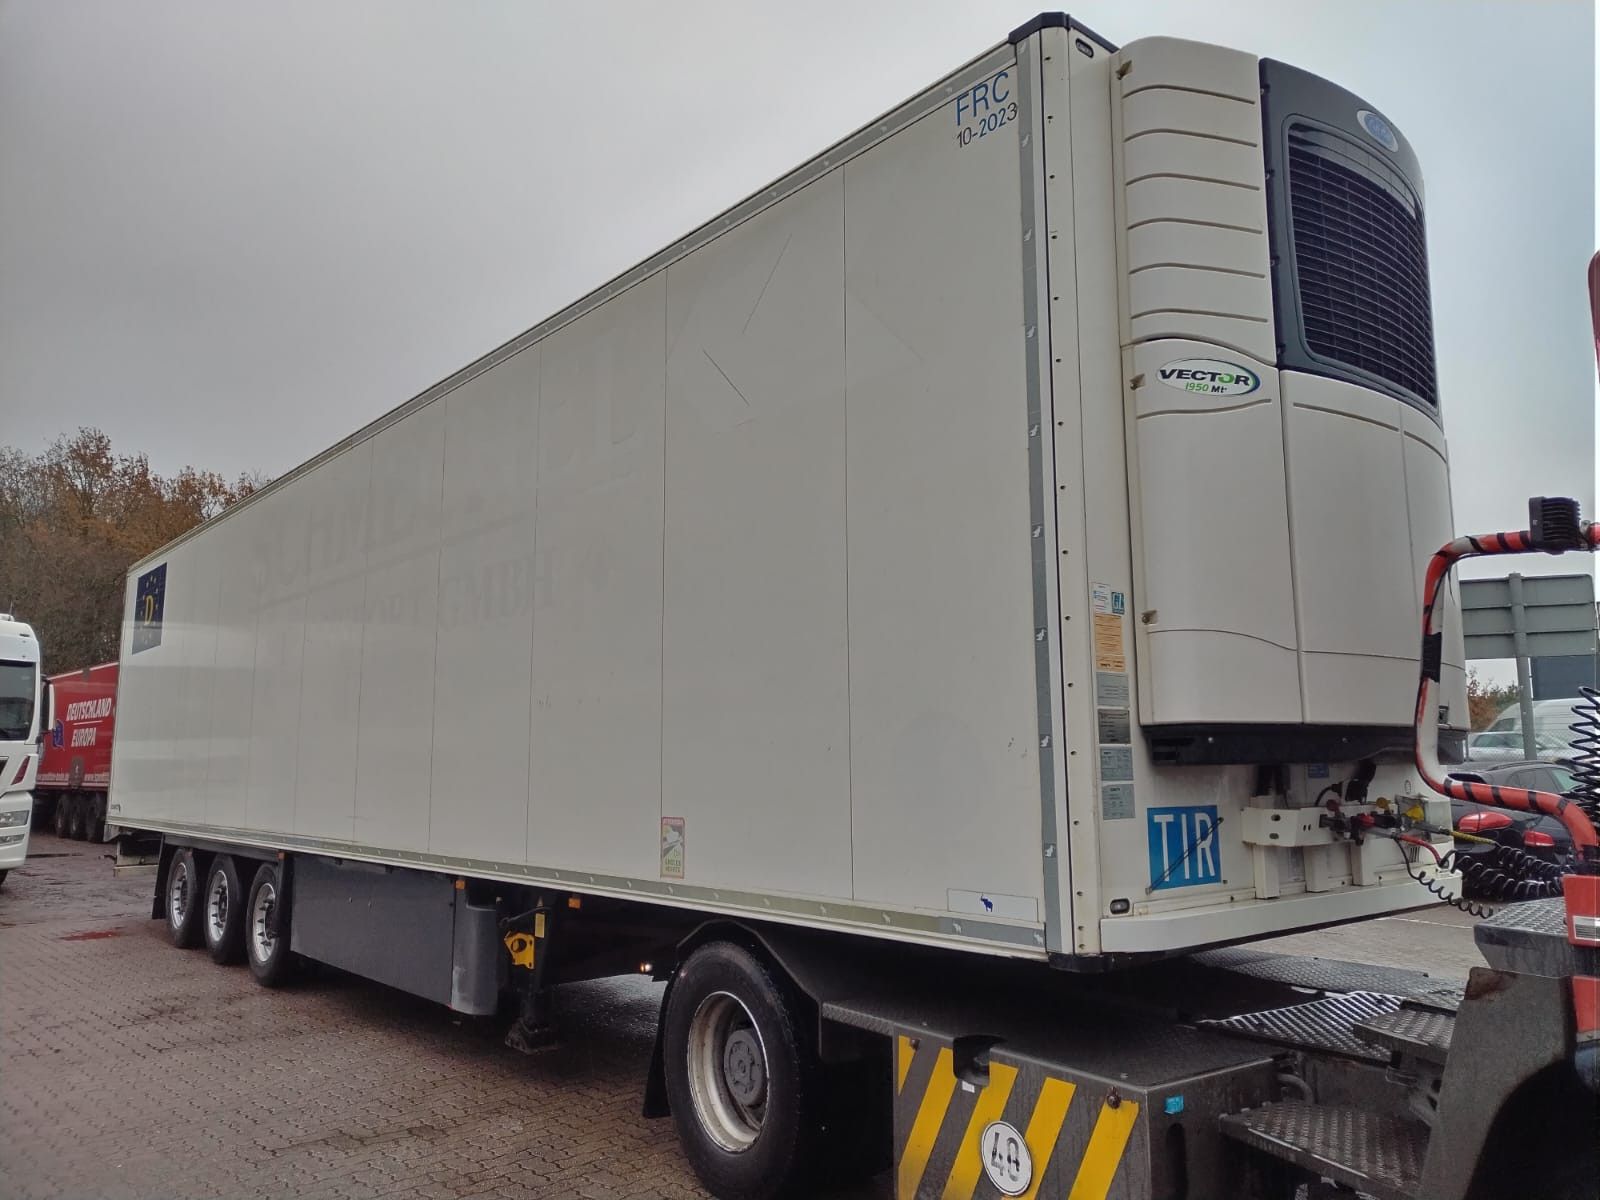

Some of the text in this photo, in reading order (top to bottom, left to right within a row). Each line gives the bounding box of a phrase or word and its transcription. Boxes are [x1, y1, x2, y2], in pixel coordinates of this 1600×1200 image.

[956, 72, 1009, 126] FRC
[957, 102, 1018, 148] 10-2023
[1160, 368, 1250, 386] VECTOR
[1185, 382, 1209, 392] 1950
[144, 594, 154, 626] D
[66, 697, 112, 721] DEUTSCHLAND
[71, 727, 96, 747] EUROPA
[1153, 812, 1216, 882] TIR
